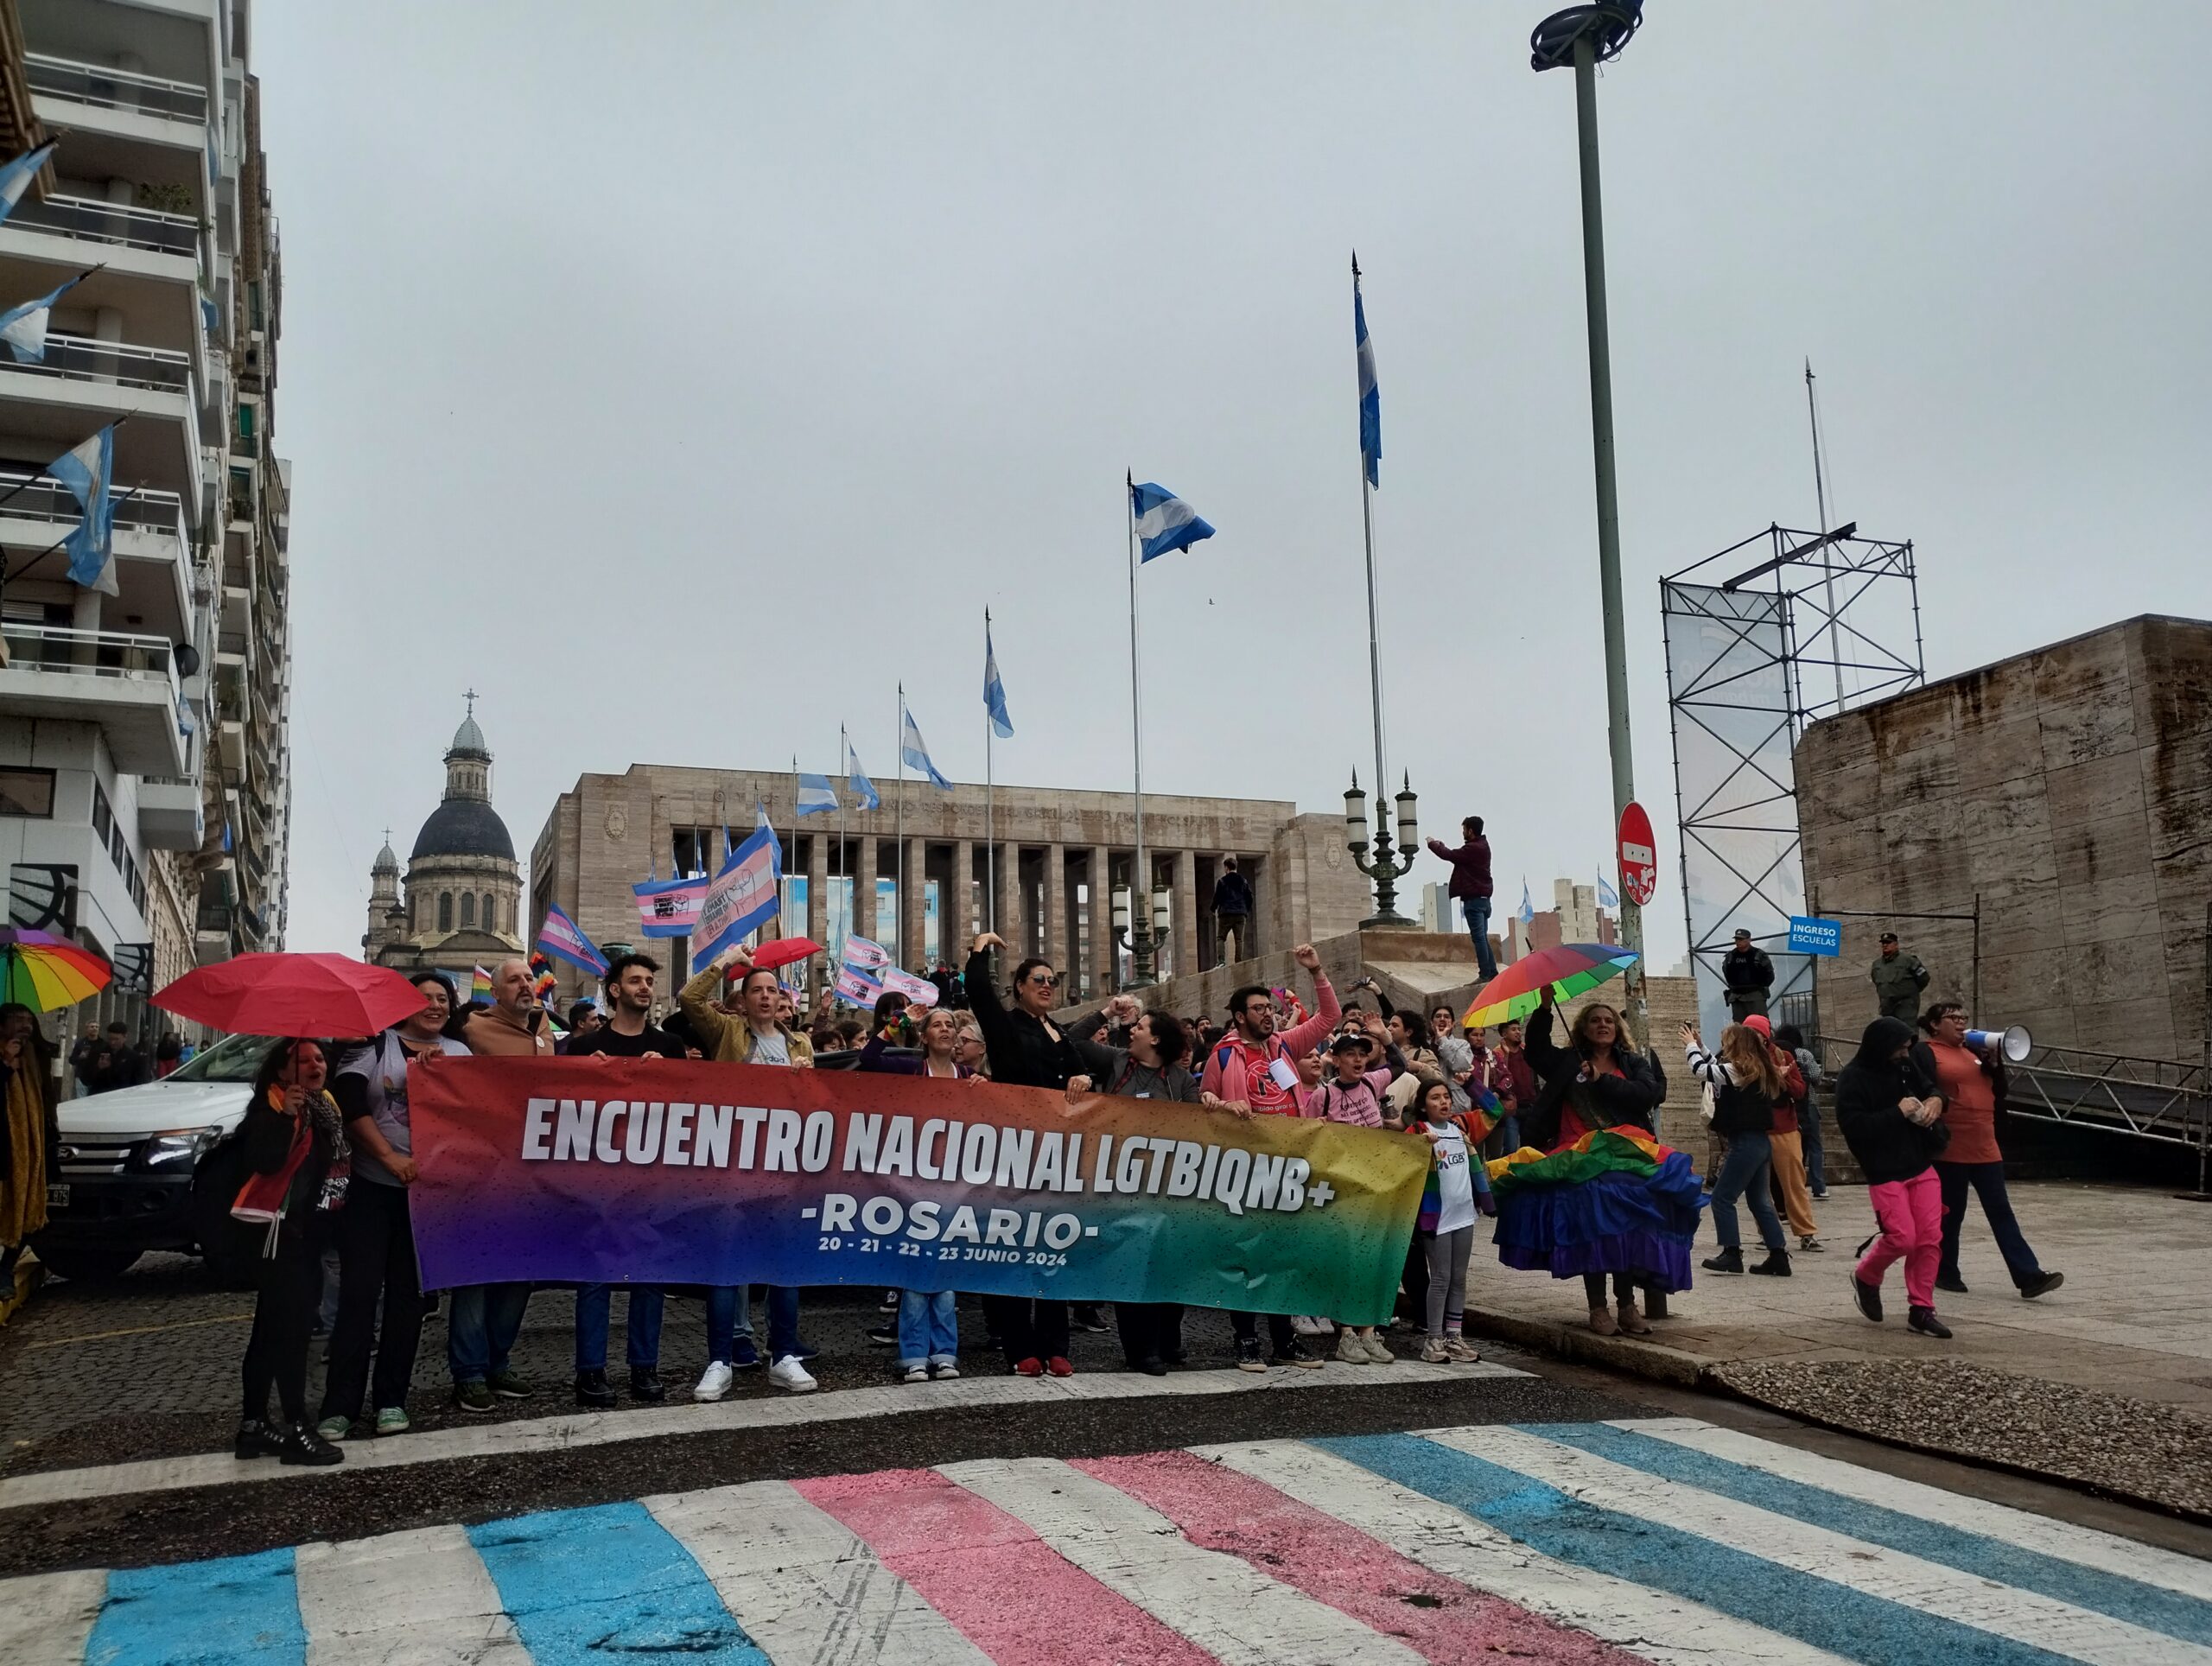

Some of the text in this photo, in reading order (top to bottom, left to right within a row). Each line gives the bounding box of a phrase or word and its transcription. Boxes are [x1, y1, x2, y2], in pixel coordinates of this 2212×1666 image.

[1792, 933, 1836, 946] ESCUELAS
[1793, 924, 1836, 937] INGRESO
[521, 1097, 1336, 1216] ENCUENTRO NACIONAL LGTBIQNB+
[801, 1193, 1099, 1250] -ROSARIO-
[818, 1237, 842, 1250] 20
[860, 1238, 880, 1252] 21
[898, 1242, 920, 1256] 22
[938, 1247, 959, 1261] 23
[963, 1250, 1021, 1262] JUNIO
[1025, 1251, 1067, 1266] 2024
